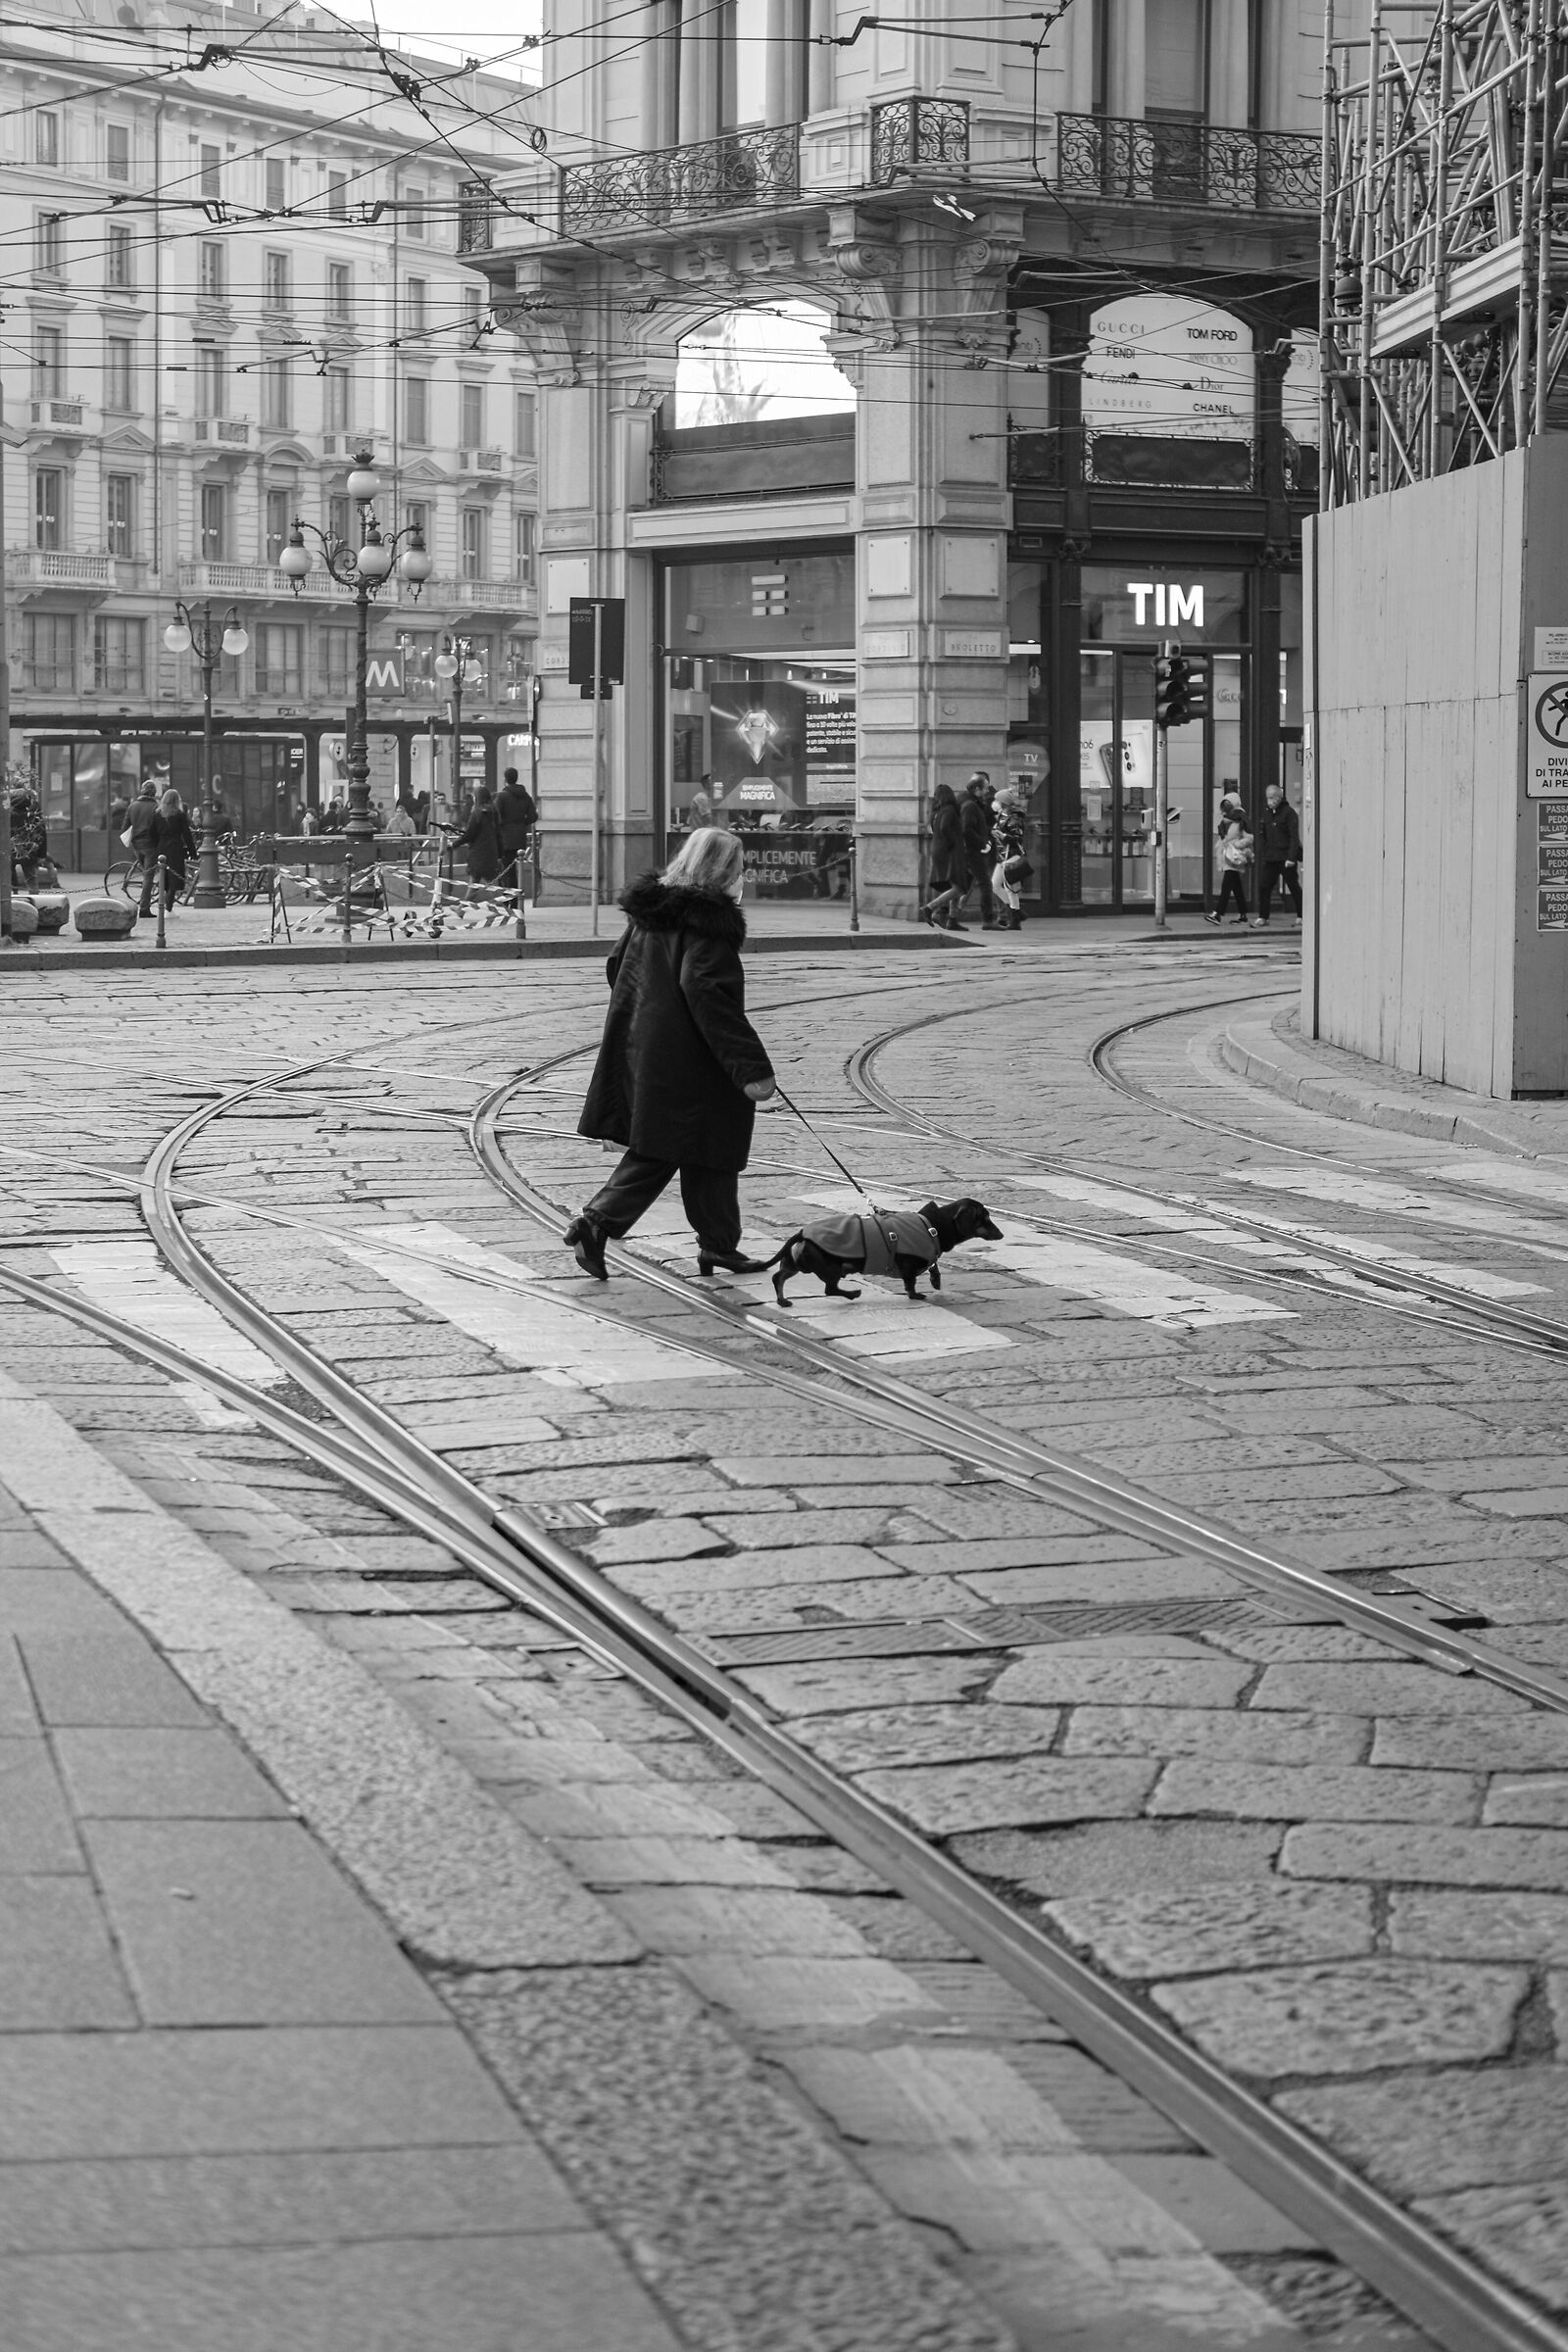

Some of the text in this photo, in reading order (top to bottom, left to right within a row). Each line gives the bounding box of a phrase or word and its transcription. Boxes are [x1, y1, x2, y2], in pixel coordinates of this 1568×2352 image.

[1097, 321, 1145, 336] GUCCI
[1186, 328, 1238, 342] TOM FORD
[1106, 346, 1136, 360] FENDI
[1200, 376, 1223, 391] Dior
[1193, 403, 1233, 415] CHANEL
[1127, 582, 1204, 627] TIM
[366, 661, 400, 687] M
[818, 690, 839, 705] TIM
[1023, 754, 1039, 762] TV
[1536, 768, 1568, 777] DI TRA
[1542, 779, 1568, 788] AI PE
[740, 791, 776, 801] MAGNIFICA
